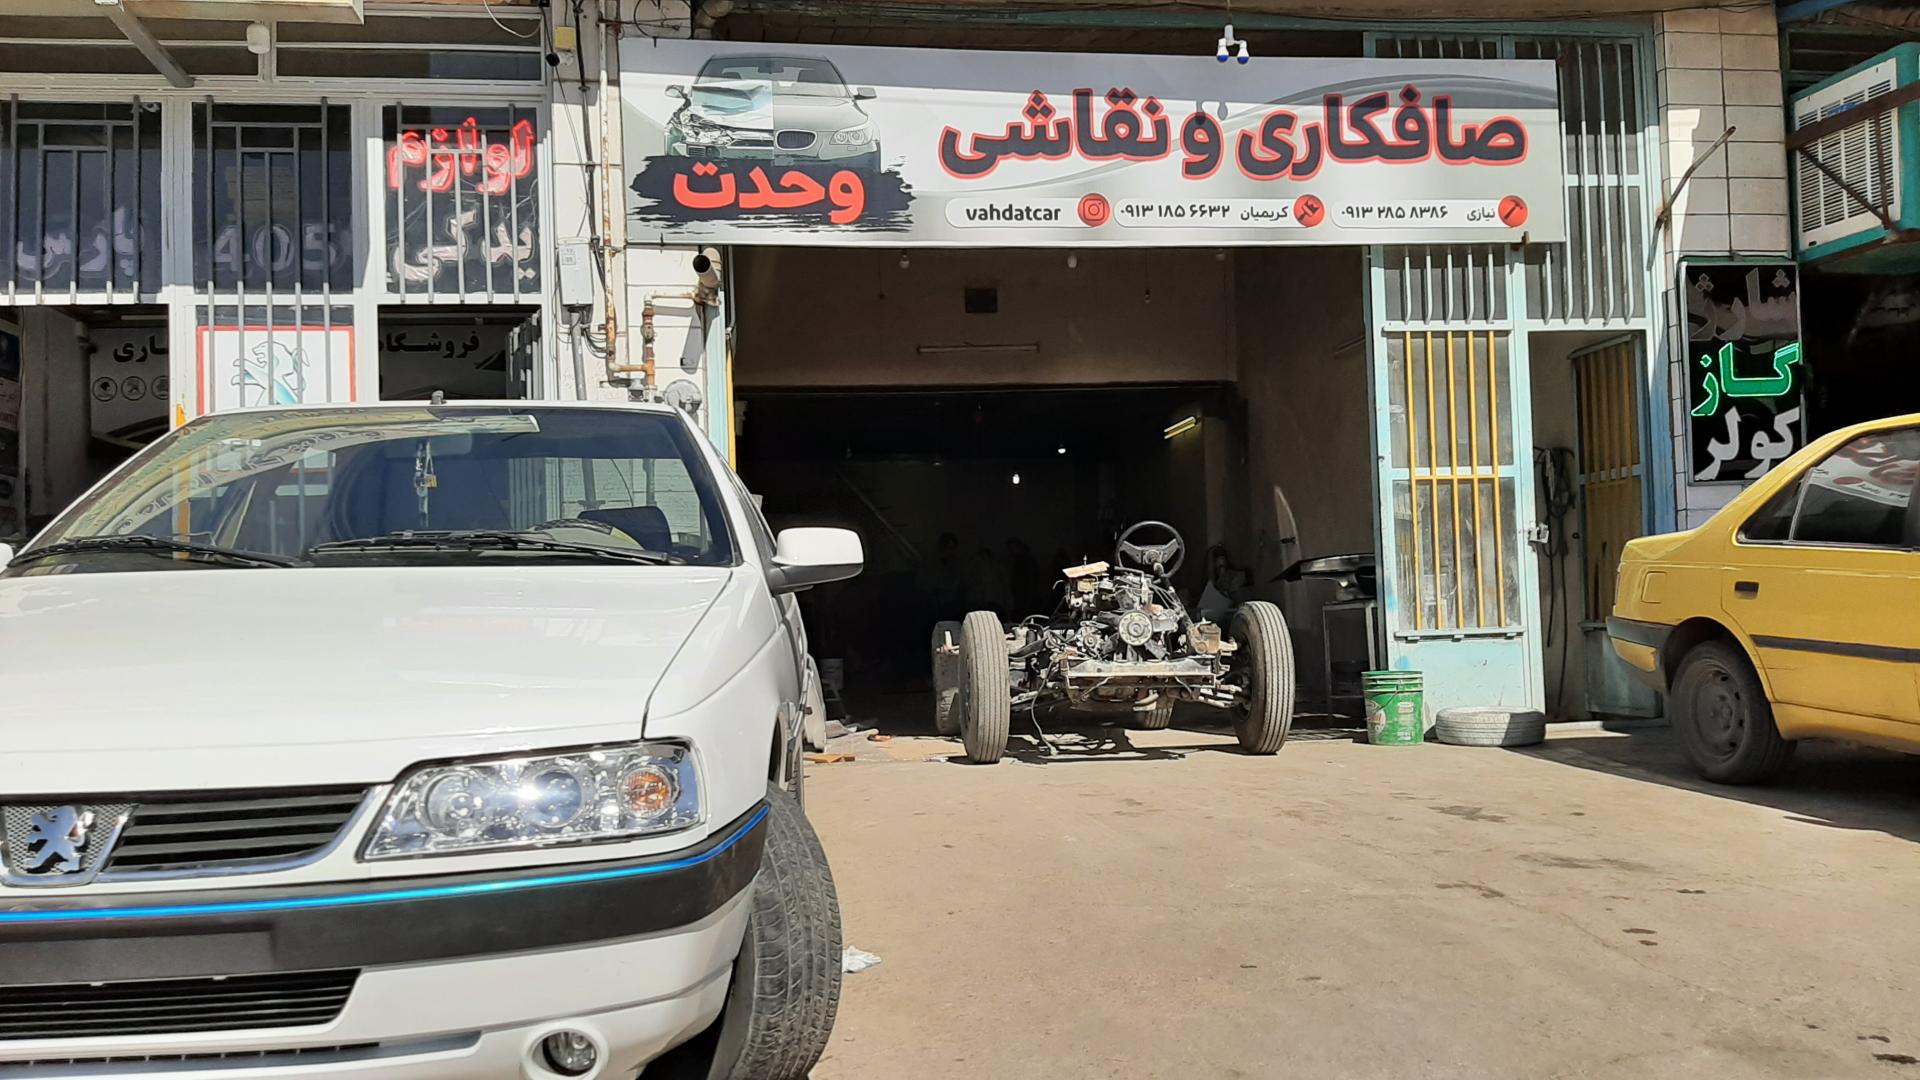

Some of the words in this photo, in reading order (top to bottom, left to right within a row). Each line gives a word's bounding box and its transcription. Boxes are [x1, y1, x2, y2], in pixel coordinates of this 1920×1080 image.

[388, 117, 534, 195] لوازم
[940, 88, 1172, 178] نقاشی
[1181, 112, 1222, 180] و
[1237, 84, 1528, 180] صافکاری
[673, 162, 865, 224] وحدت
[965, 203, 1062, 222] vahdatcar
[1158, 203, 1186, 218] ۱۸۵
[1240, 206, 1289, 221] کریمیان
[1466, 207, 1496, 222] نیازی
[213, 223, 340, 272] 405
[1690, 341, 1800, 416] گاز
[1694, 405, 1800, 480] کولر
